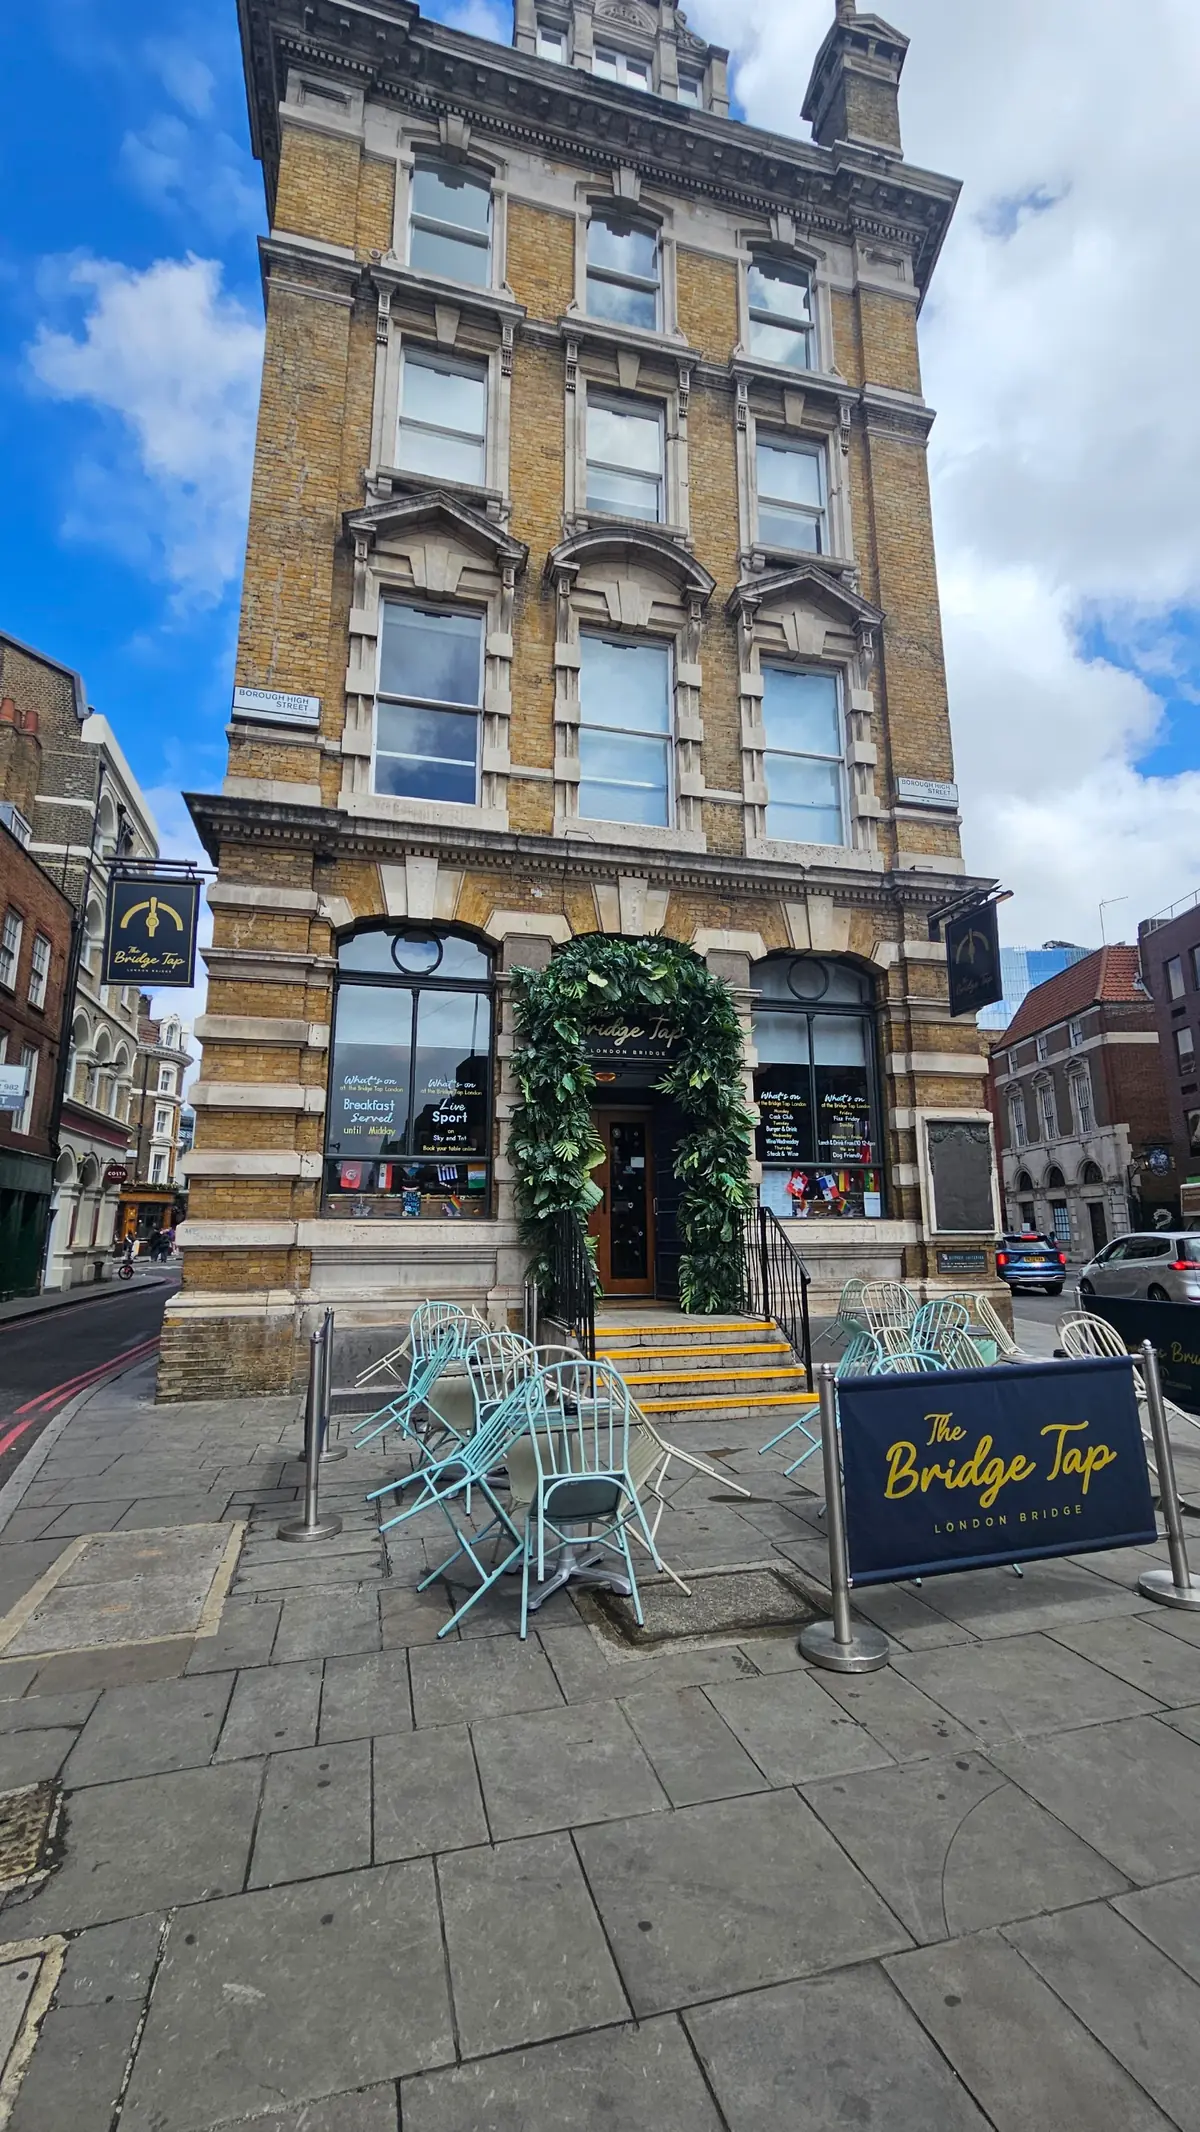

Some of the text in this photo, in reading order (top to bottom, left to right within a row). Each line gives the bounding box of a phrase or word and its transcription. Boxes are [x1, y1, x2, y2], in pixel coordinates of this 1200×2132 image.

[239, 689, 309, 704] BOROUGH HIGH
[276, 701, 308, 712] STREET
[902, 780, 933, 788] BOROUGH
[928, 788, 950, 796] STREET
[128, 946, 140, 954] The
[114, 950, 186, 969] Bridge Tap
[648, 1014, 687, 1048] Tap
[344, 1075, 382, 1085] What's
[428, 1079, 462, 1089] What's
[761, 1091, 788, 1100] What's
[824, 1094, 852, 1103] What's
[344, 1098, 395, 1111] Breakfast
[440, 1098, 466, 1111] Live
[351, 1112, 394, 1123] Served
[432, 1111, 468, 1124] Sport
[344, 1126, 396, 1136] until Midday
[924, 1412, 967, 1447] The
[884, 1420, 1117, 1509] Bridge Tap
[934, 1504, 1083, 1534] LONDON BRIDGE
